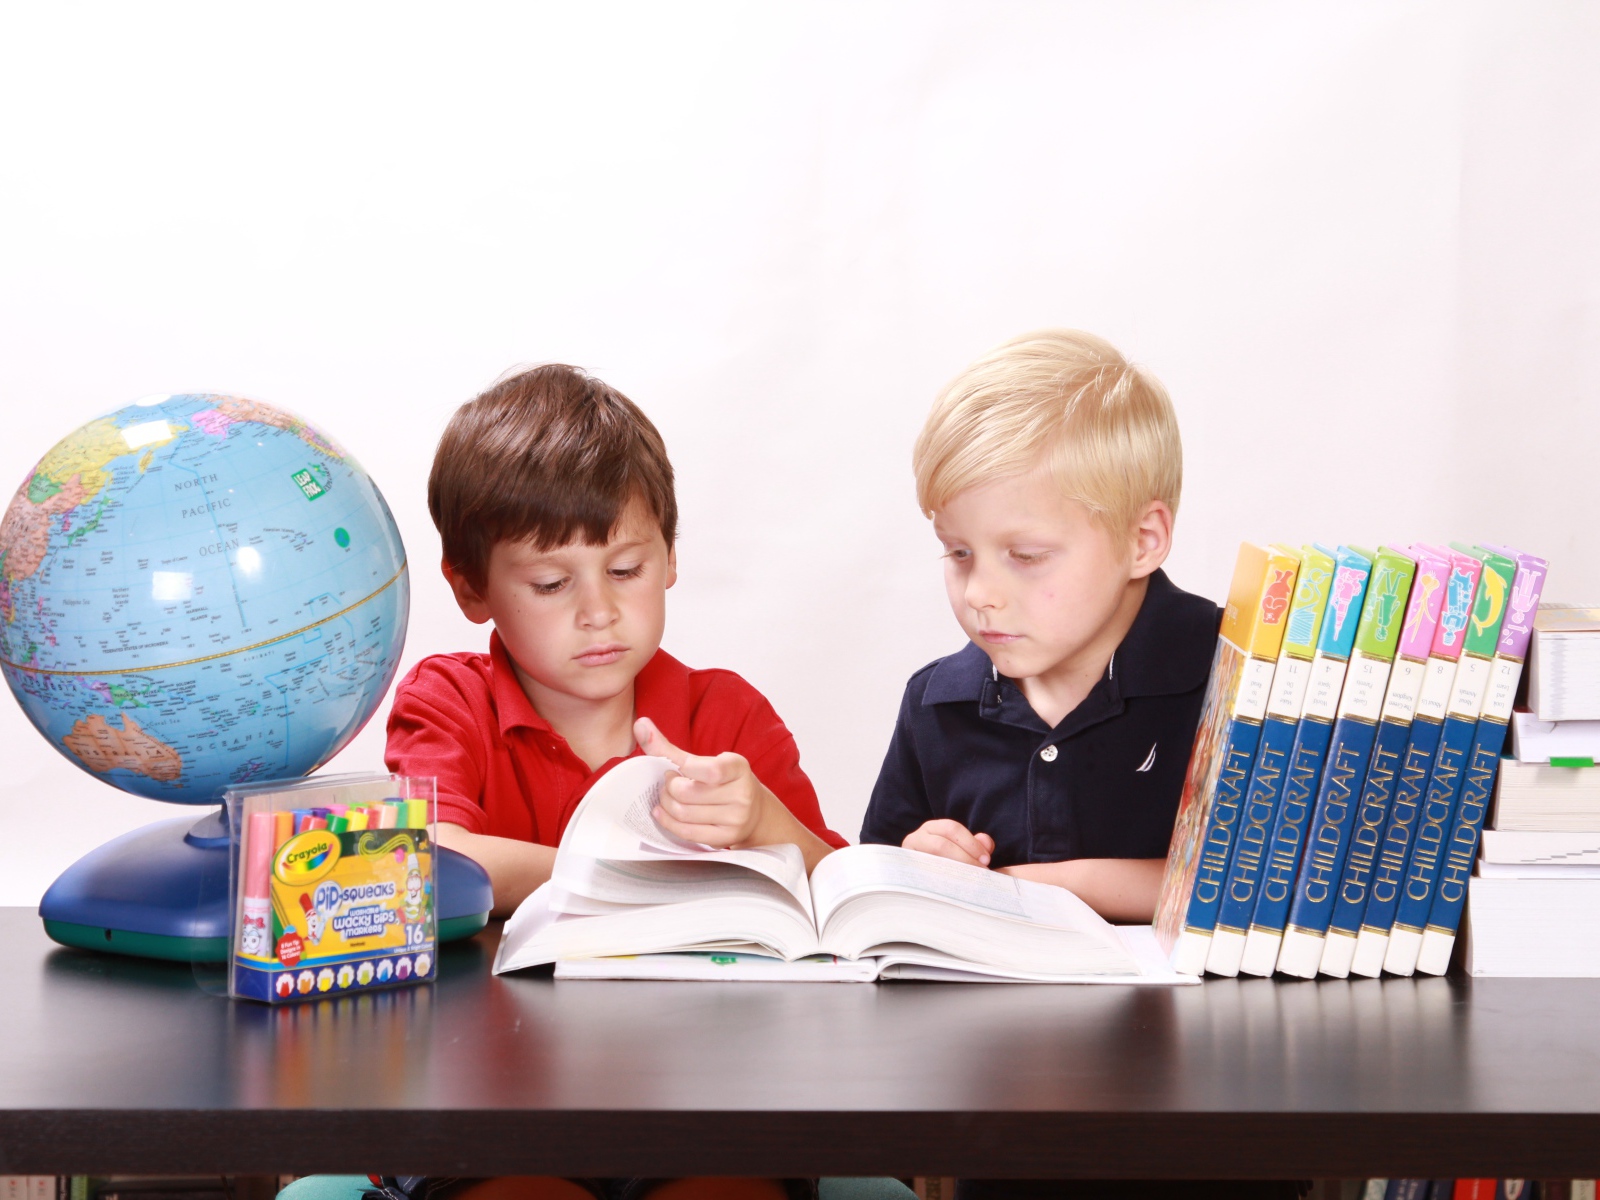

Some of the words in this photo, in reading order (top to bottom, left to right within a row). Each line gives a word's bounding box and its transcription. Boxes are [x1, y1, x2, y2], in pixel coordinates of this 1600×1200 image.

[174, 474, 218, 491] NORTH
[182, 498, 230, 518] PACIFIC
[199, 538, 240, 556] OCEAN
[293, 471, 312, 486] LEAP
[302, 482, 322, 498] FROG
[286, 842, 328, 864] Crayola
[1196, 744, 1250, 903] CHILDCRAFT
[1230, 742, 1284, 902] CHILDCRAFT
[1265, 742, 1319, 902] CHILDCRAFT
[1306, 742, 1360, 902] CHILDCRAFT
[1342, 744, 1398, 904] CHILDCRAFT
[1374, 743, 1430, 902] CHILDCRAFT
[1406, 741, 1463, 901] CHILDCRAFT
[1440, 743, 1497, 902] CHILDCRAFT
[406, 924, 424, 946] 16
